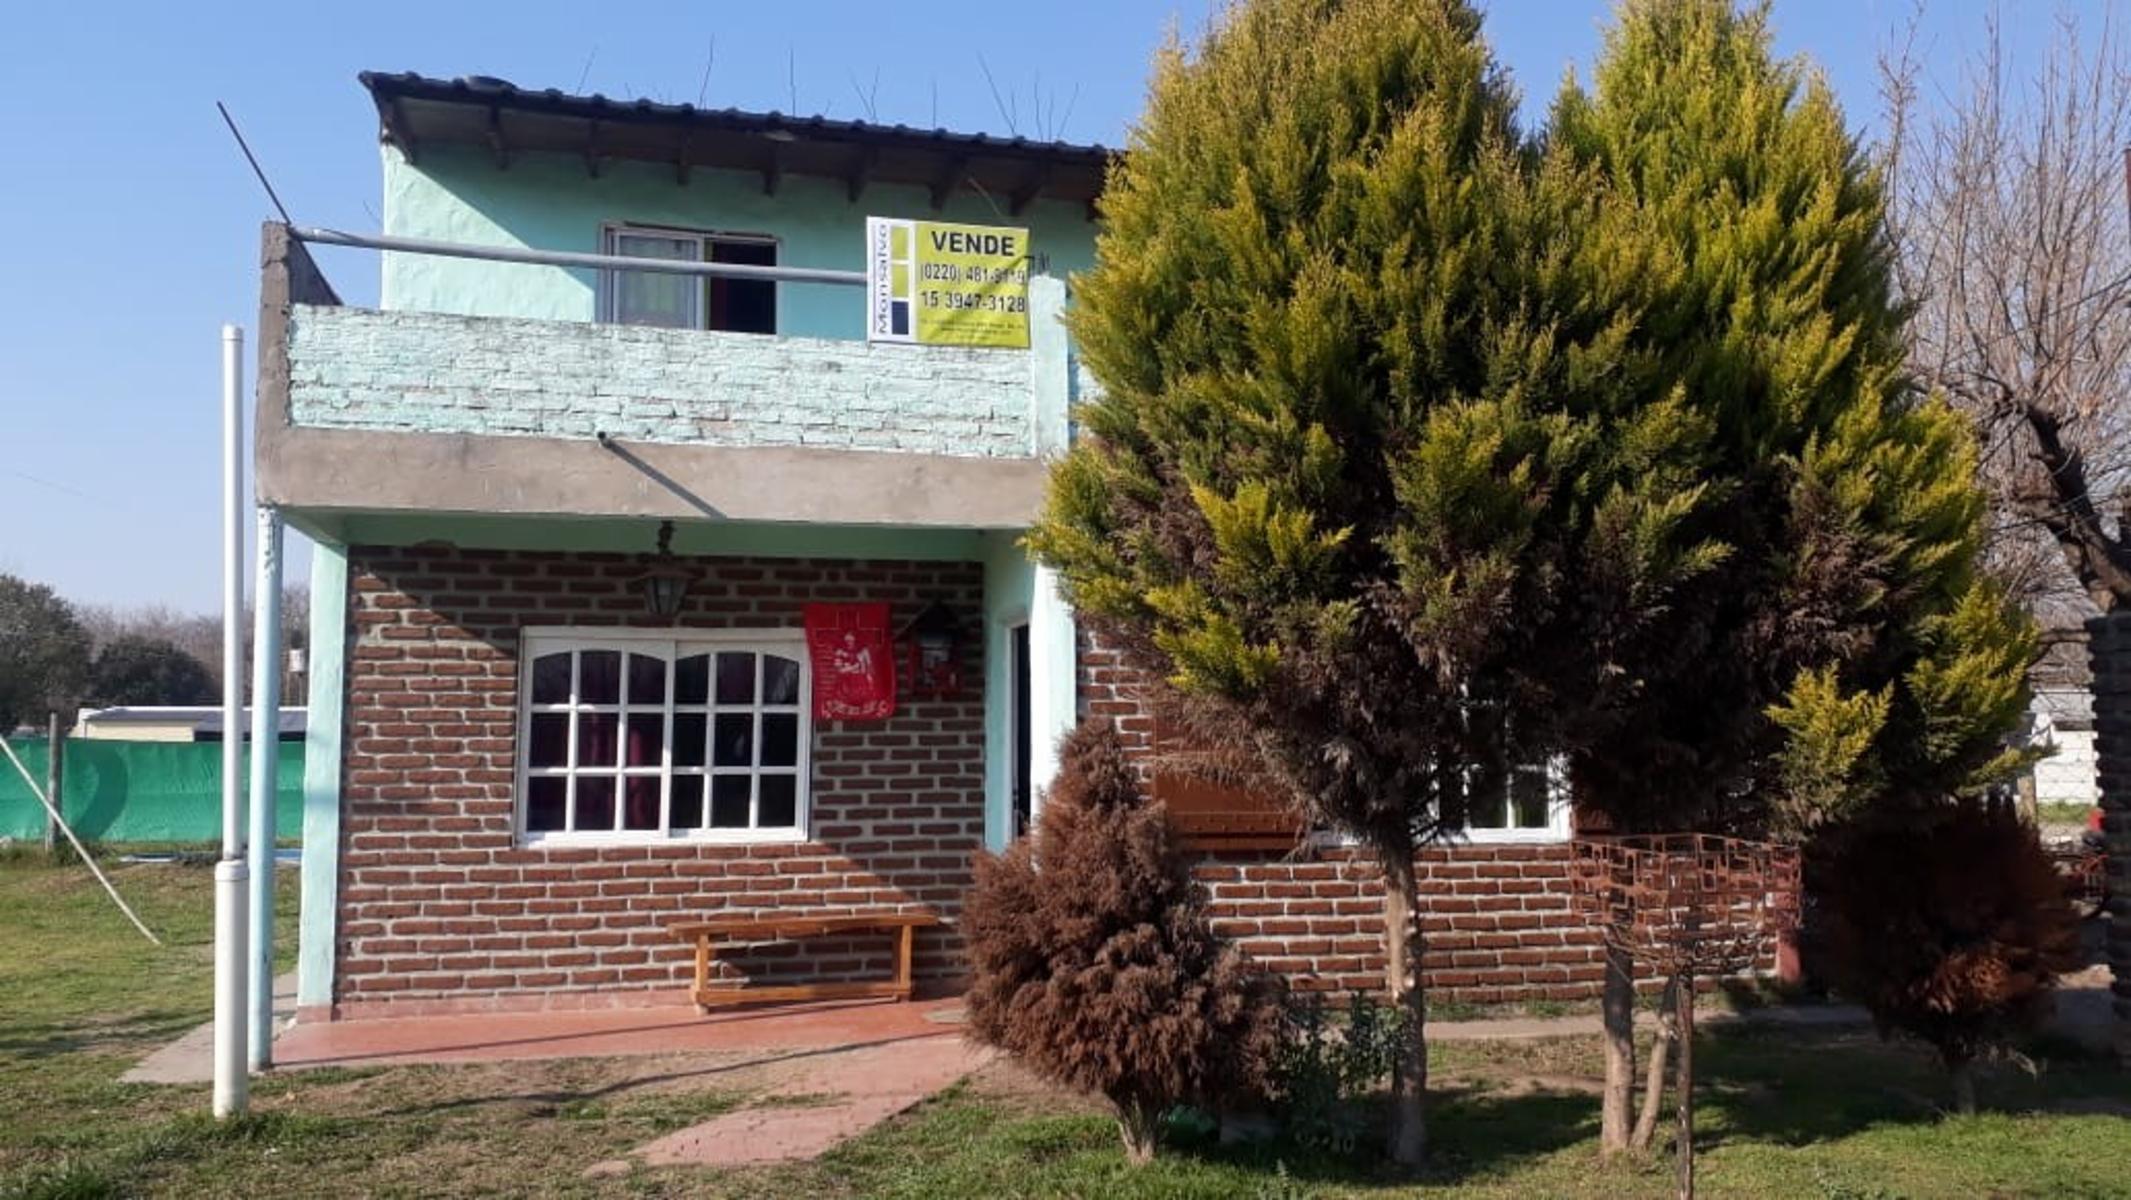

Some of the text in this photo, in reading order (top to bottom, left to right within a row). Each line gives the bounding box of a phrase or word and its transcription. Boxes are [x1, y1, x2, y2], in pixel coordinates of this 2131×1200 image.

[931, 230, 1015, 257] VENDE
[877, 224, 889, 334] Monsalvo
[920, 263, 961, 285] (0220)
[921, 290, 1025, 313] 15 3947-3128
